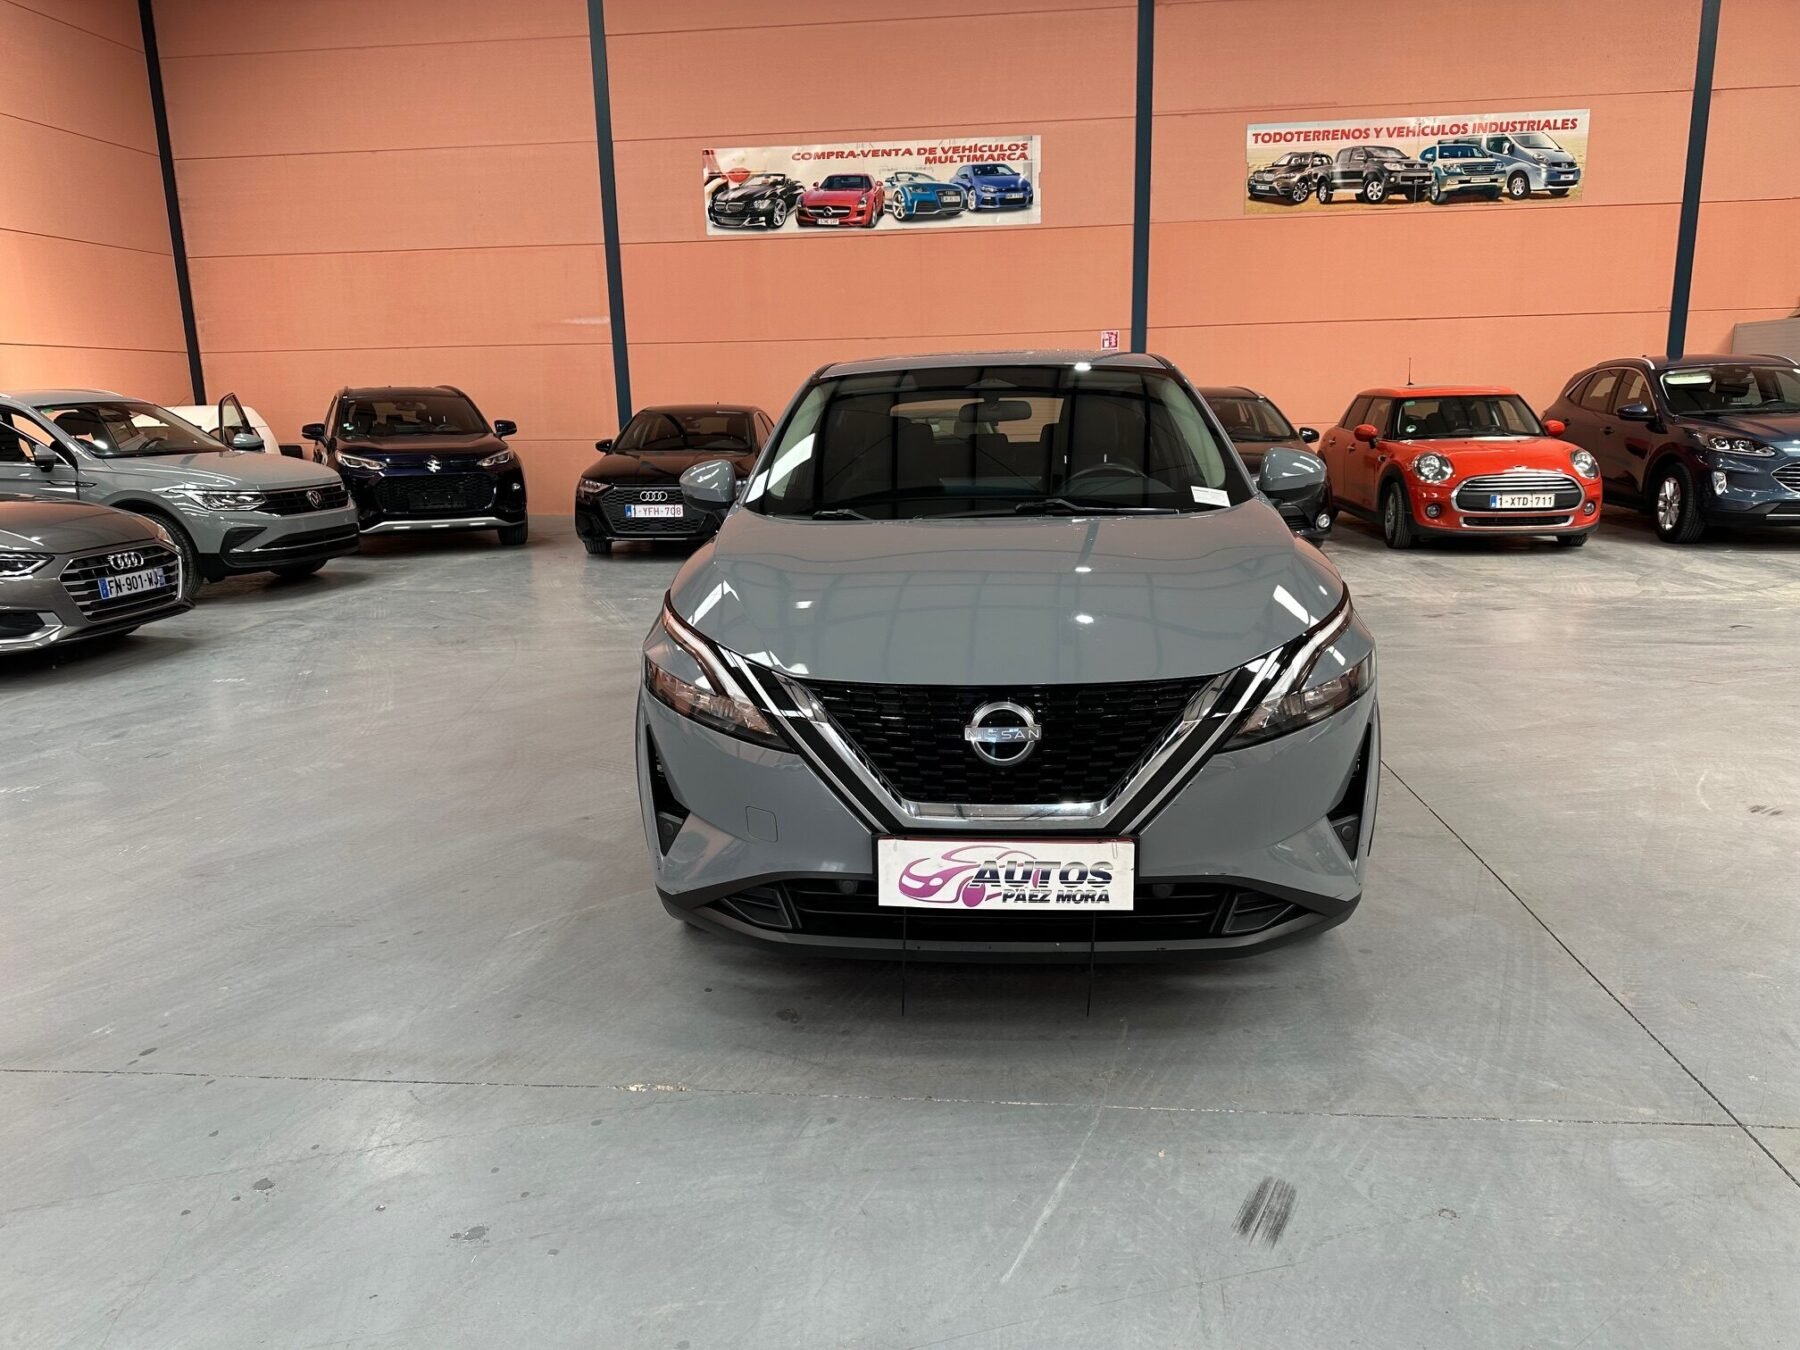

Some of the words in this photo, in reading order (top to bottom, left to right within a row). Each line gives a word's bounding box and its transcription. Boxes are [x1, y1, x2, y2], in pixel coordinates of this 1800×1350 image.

[1252, 128, 1371, 145] TODOTERRENOS
[1374, 127, 1384, 138] Y
[1386, 122, 1469, 138] VEHÍCULOS
[1471, 118, 1578, 134] INDUSTRIALES
[791, 148, 913, 161] COMPRA-VENTA
[917, 147, 937, 155] DE
[941, 143, 1029, 155] VEHÍCULOS
[924, 152, 1029, 165] MULTIMARCA
[1498, 496, 1552, 506] 1-XTD-711
[966, 729, 1040, 740] NISSAN
[969, 860, 1113, 888] AUTOS
[1056, 889, 1110, 904] MORA
